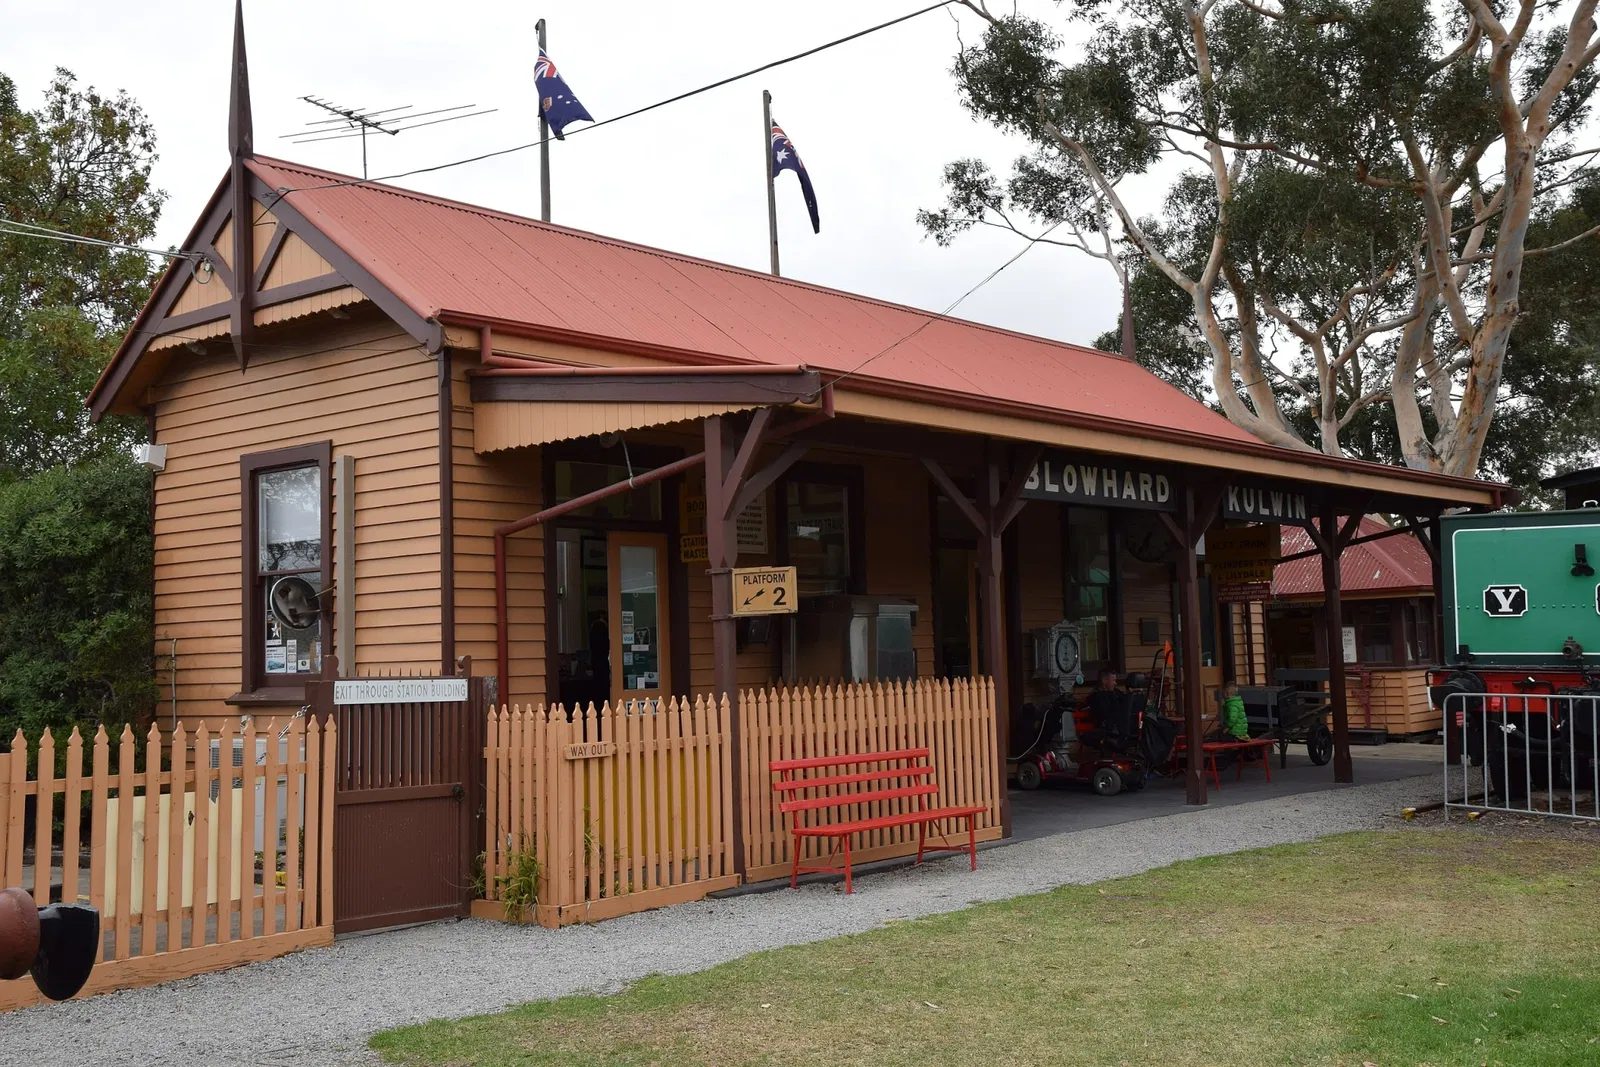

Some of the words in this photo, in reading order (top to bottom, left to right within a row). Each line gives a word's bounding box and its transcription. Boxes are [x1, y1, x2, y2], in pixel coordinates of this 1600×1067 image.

[1024, 460, 1170, 503] BLOWHARD
[1227, 485, 1307, 519] KULWIN
[743, 573, 786, 585] PLATFORM
[773, 586, 787, 606] 2
[1490, 588, 1520, 613] Y
[335, 685, 353, 700] EXIT
[356, 685, 393, 699] THROUGH
[396, 684, 429, 698] STATION
[431, 683, 466, 697] BUILDING
[627, 700, 660, 716] ETY
[570, 745, 588, 757] WAY
[591, 743, 608, 756] OUT
